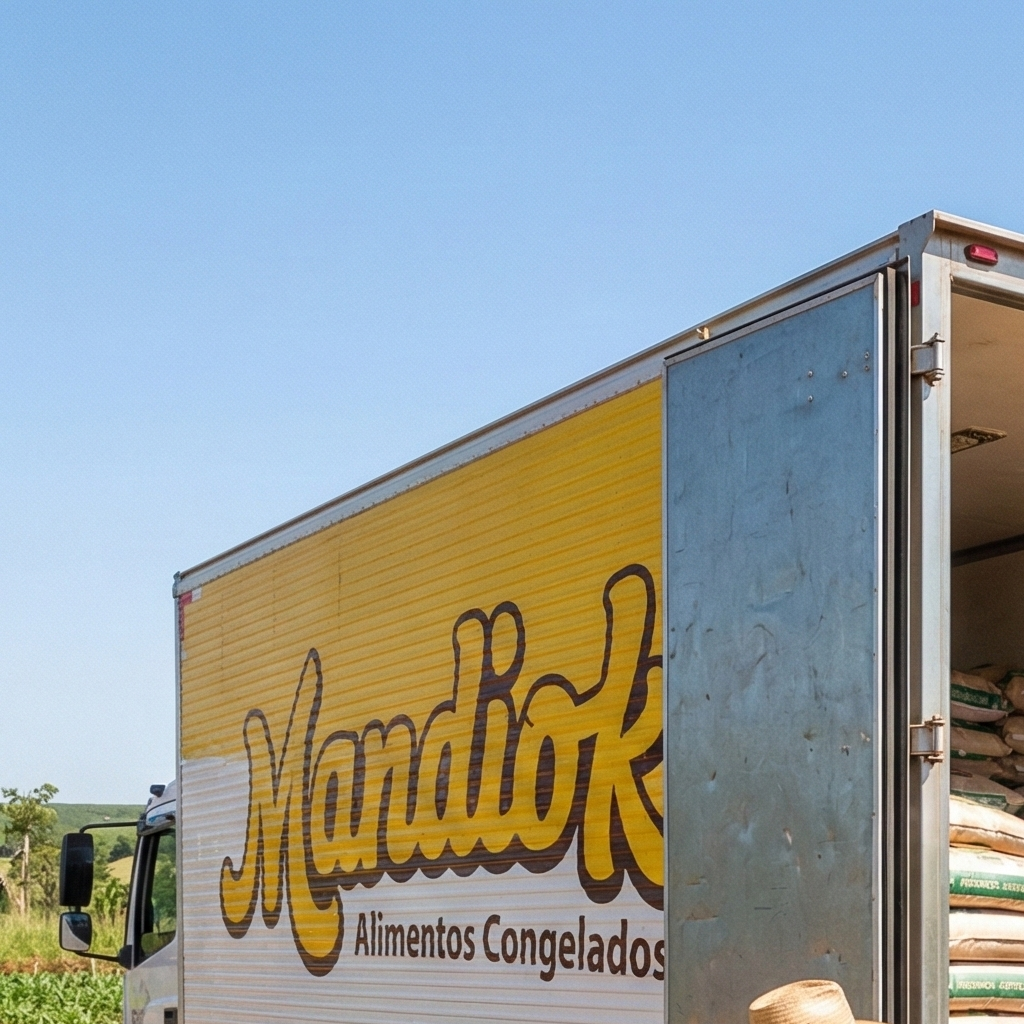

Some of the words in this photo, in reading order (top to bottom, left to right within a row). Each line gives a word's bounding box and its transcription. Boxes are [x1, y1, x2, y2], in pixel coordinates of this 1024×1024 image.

[220, 564, 664, 977] Mandiok
[354, 910, 475, 961] Alimentos
[482, 914, 664, 982] Congelados
